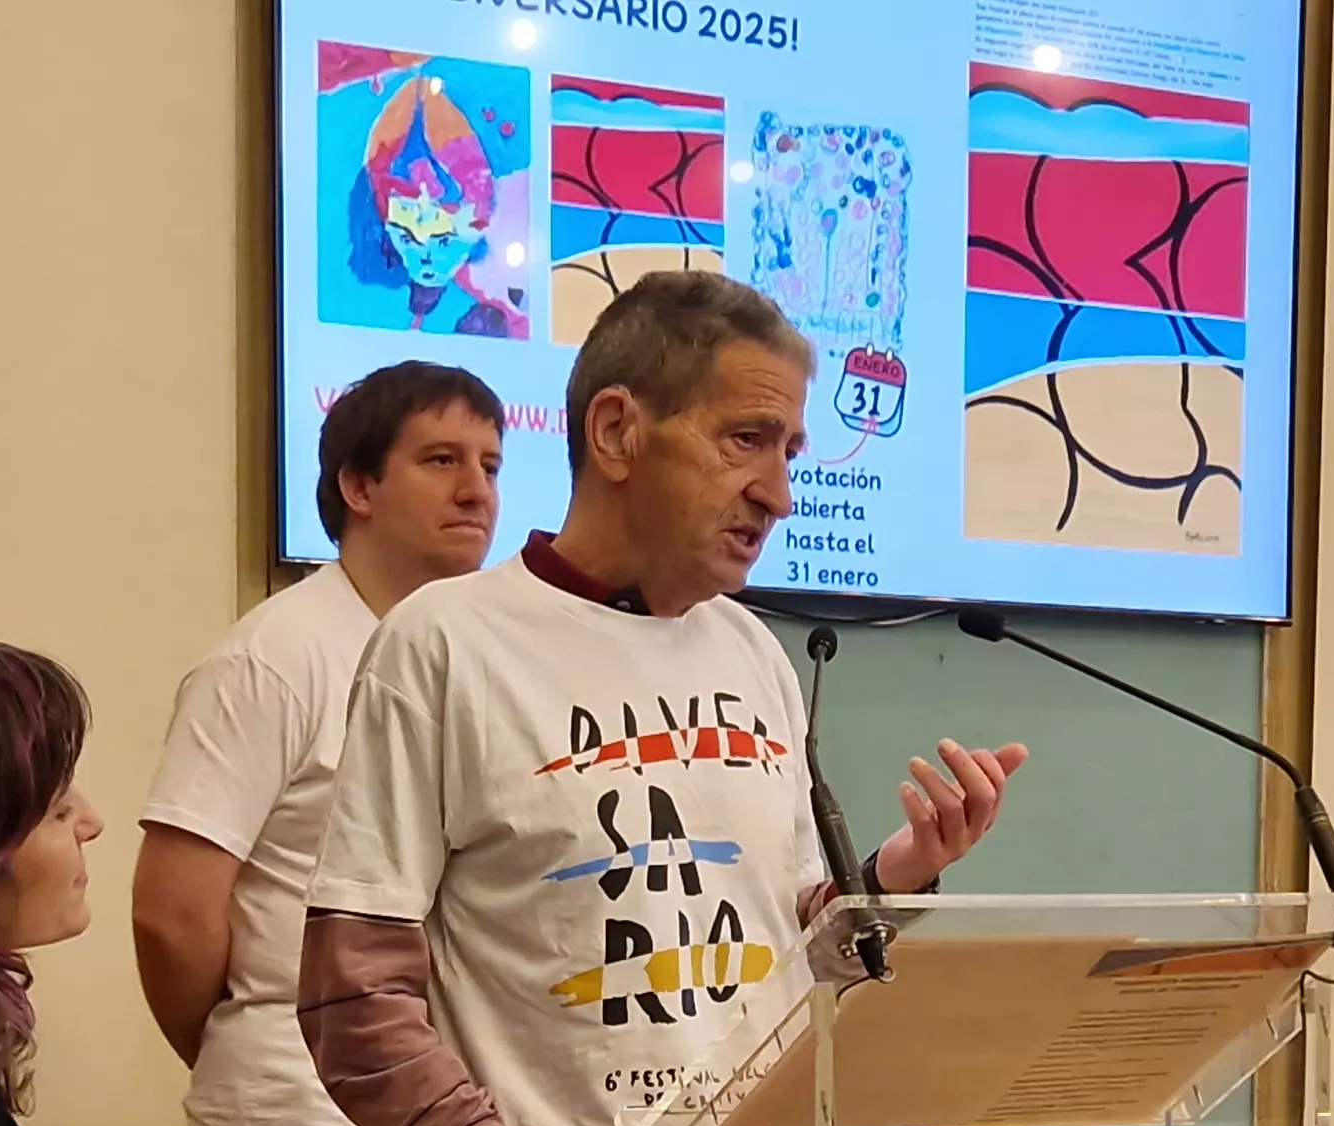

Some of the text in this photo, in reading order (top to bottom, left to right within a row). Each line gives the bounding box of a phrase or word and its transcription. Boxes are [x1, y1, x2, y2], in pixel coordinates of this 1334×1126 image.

[698, 5, 798, 51] 2025!
[854, 357, 900, 378] ENERO
[852, 382, 881, 416] 31
[788, 466, 881, 490] votación
[786, 528, 875, 554] hasta el
[787, 561, 878, 587] 31 enero
[597, 785, 702, 900] SA
[601, 899, 744, 1026] RIO
